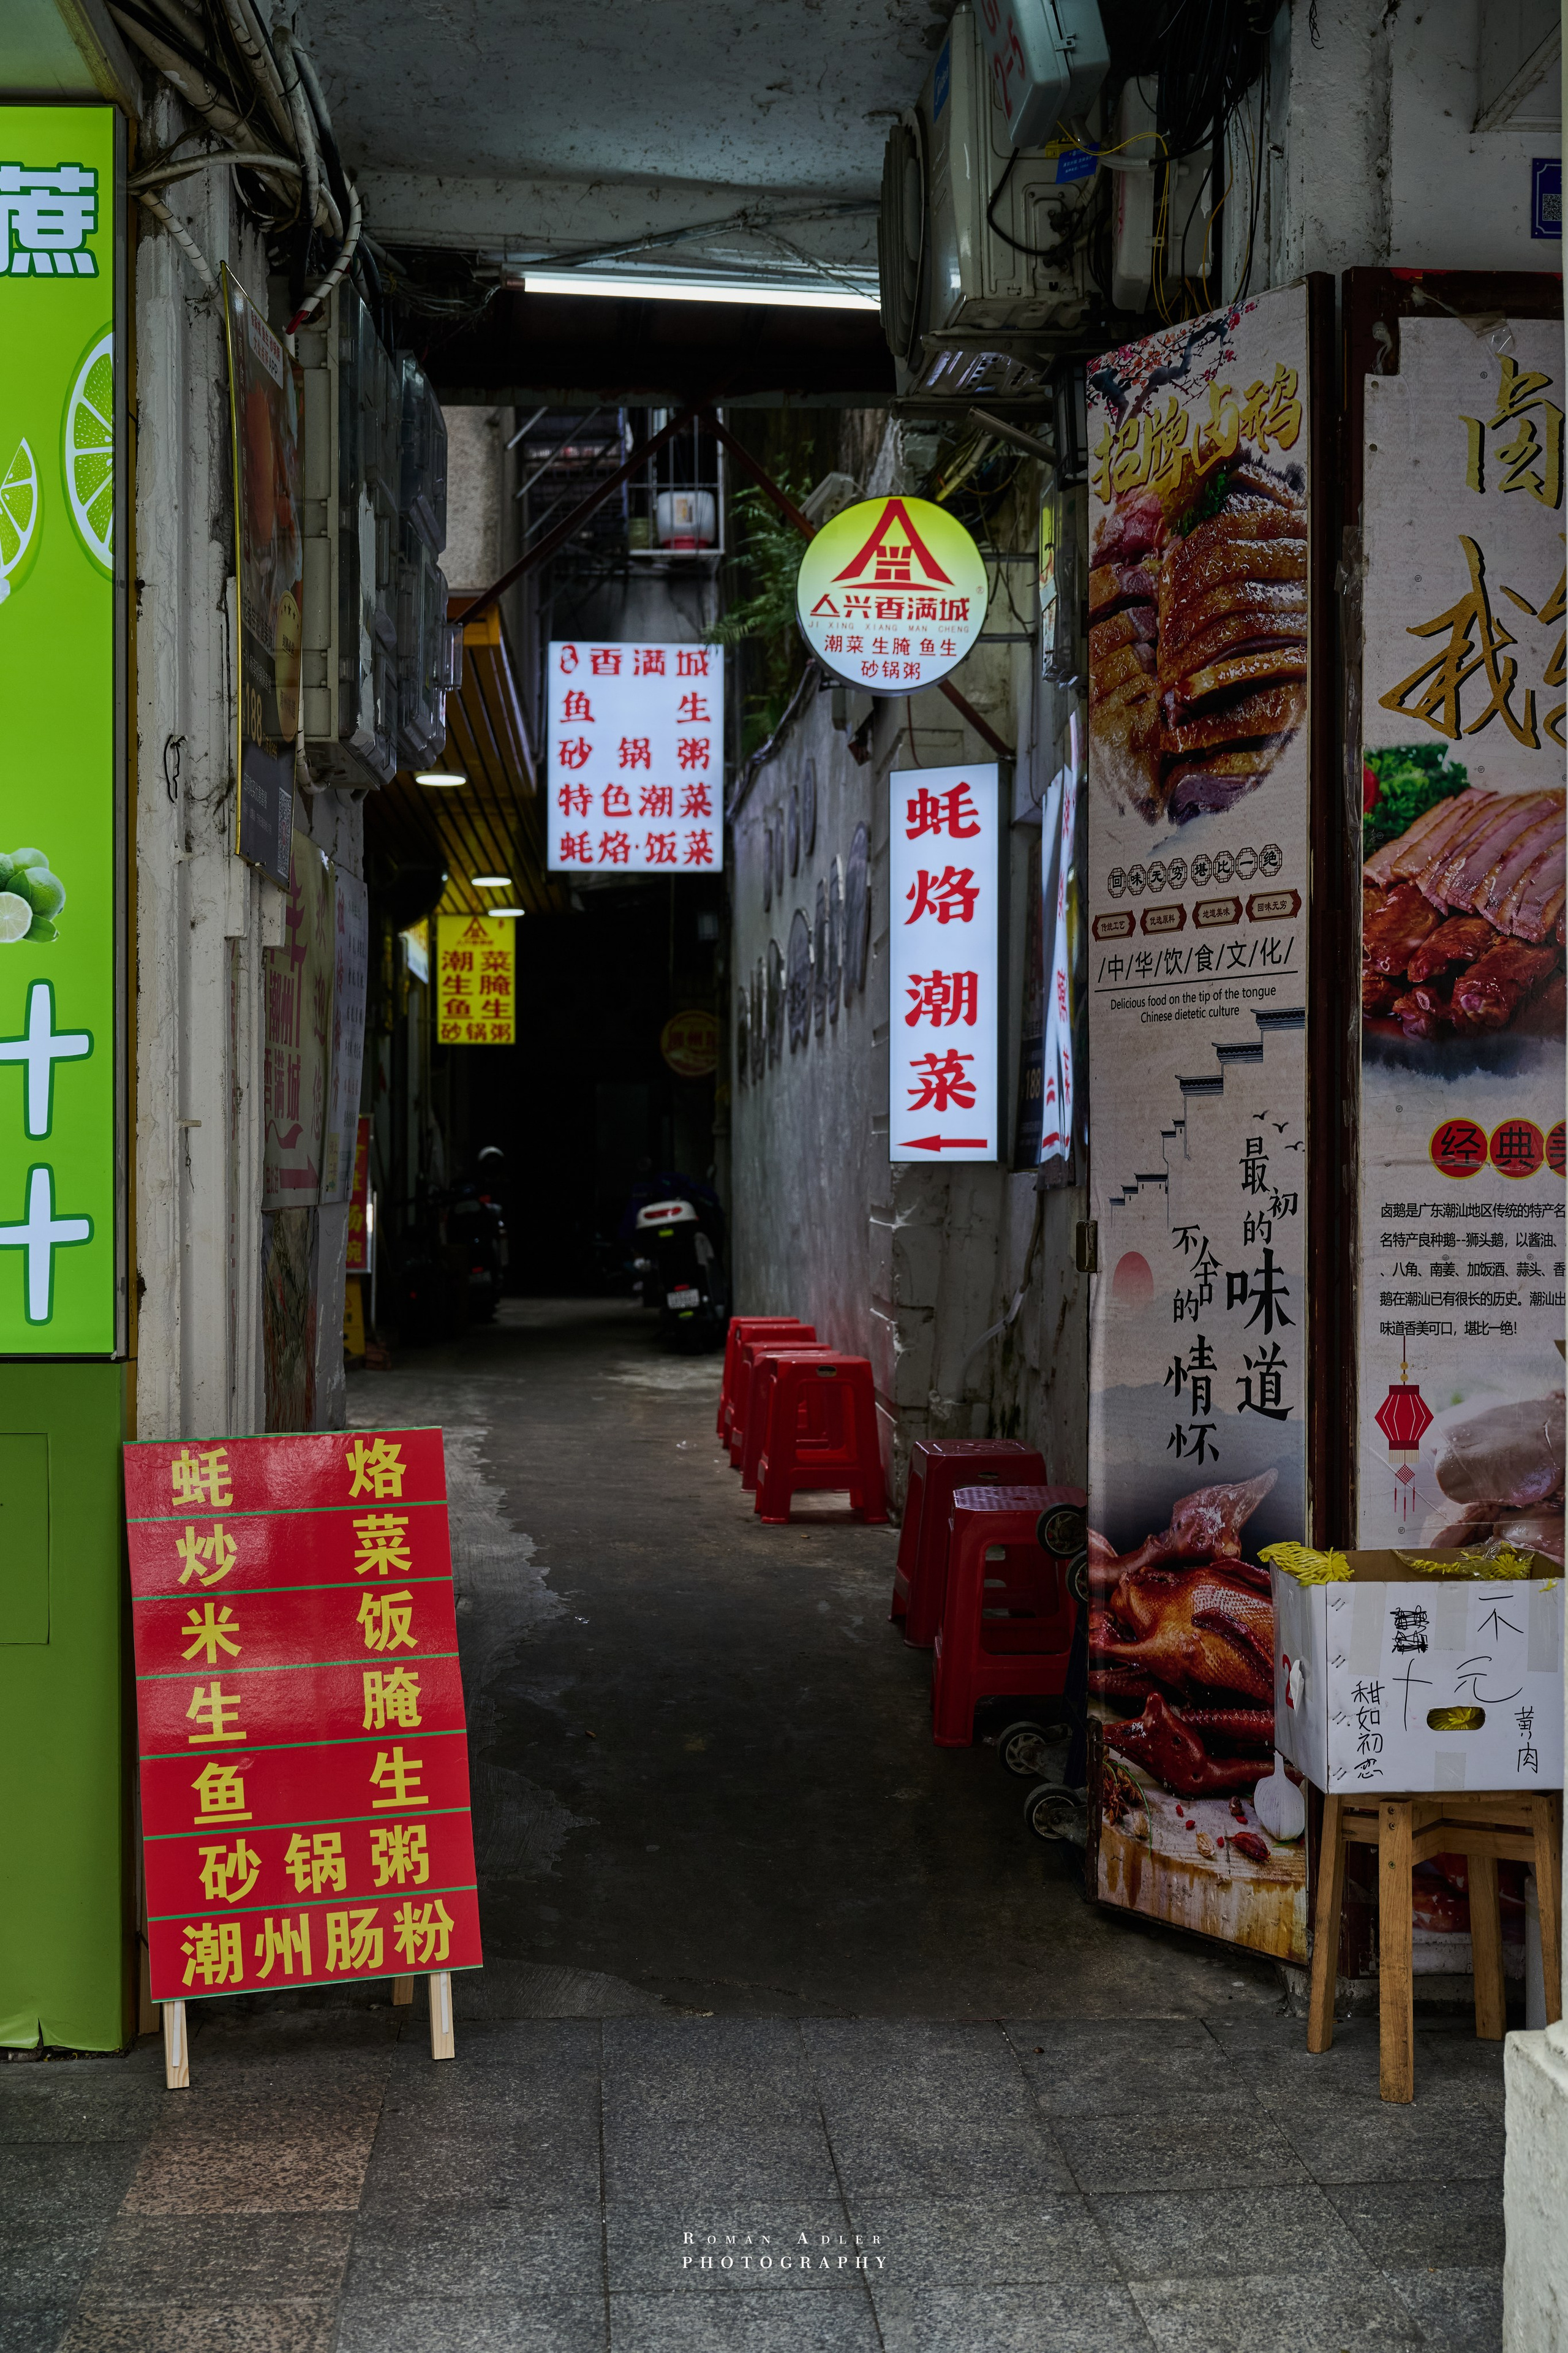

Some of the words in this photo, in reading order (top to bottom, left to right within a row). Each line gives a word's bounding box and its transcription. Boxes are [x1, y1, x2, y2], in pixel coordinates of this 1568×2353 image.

[269, 357, 278, 379] APP
[1091, 362, 1302, 504] 招牌卤鹅
[824, 635, 864, 654] 潮菜
[872, 637, 911, 655] 生腌
[919, 638, 957, 657] 鱼生
[865, 623, 898, 632] XIANG
[861, 660, 921, 680] 砂锅粥
[558, 737, 710, 770] 砂锅粥
[558, 782, 712, 818] 特色潮菜
[904, 782, 981, 925] 蚝烙
[1110, 864, 1185, 890] 回味无穷
[1193, 850, 1280, 878] 堪比一绝
[1101, 921, 1125, 932] 传统工艺
[1150, 913, 1175, 926] 优选原料
[1202, 907, 1231, 919] 地道美味
[1257, 900, 1287, 912] 回味无穷
[442, 950, 511, 972] 潮菜
[442, 974, 511, 995] 生腌
[1110, 995, 1146, 1011] Delicious
[1148, 992, 1167, 1007] food
[1169, 995, 1180, 1005] on
[1182, 991, 1197, 1003] the
[1198, 989, 1211, 1005] tip
[1213, 988, 1223, 1000] of
[1224, 987, 1240, 1000] the
[1242, 985, 1276, 1002] tongue
[269, 974, 295, 1048] 潮州
[443, 998, 512, 1019] 鱼生
[1140, 1008, 1173, 1023] Chinese
[1174, 1007, 1206, 1021] dietetic
[1208, 1005, 1240, 1016] culture
[441, 1022, 511, 1041] 砂锅粥
[904, 969, 979, 1112] 潮菜
[1225, 1136, 1298, 1422] 最初的味道
[172, 1438, 407, 1509] 蚝烙
[176, 1514, 412, 1587] 炒菜
[181, 1589, 418, 1664] 米饭
[186, 1669, 423, 1744] 生腌
[1514, 1705, 1539, 1774] 黄肉
[192, 1747, 429, 1826] 鱼生
[198, 1824, 431, 1905] 砂锅粥
[181, 1899, 455, 1987] 潮州肠粉
